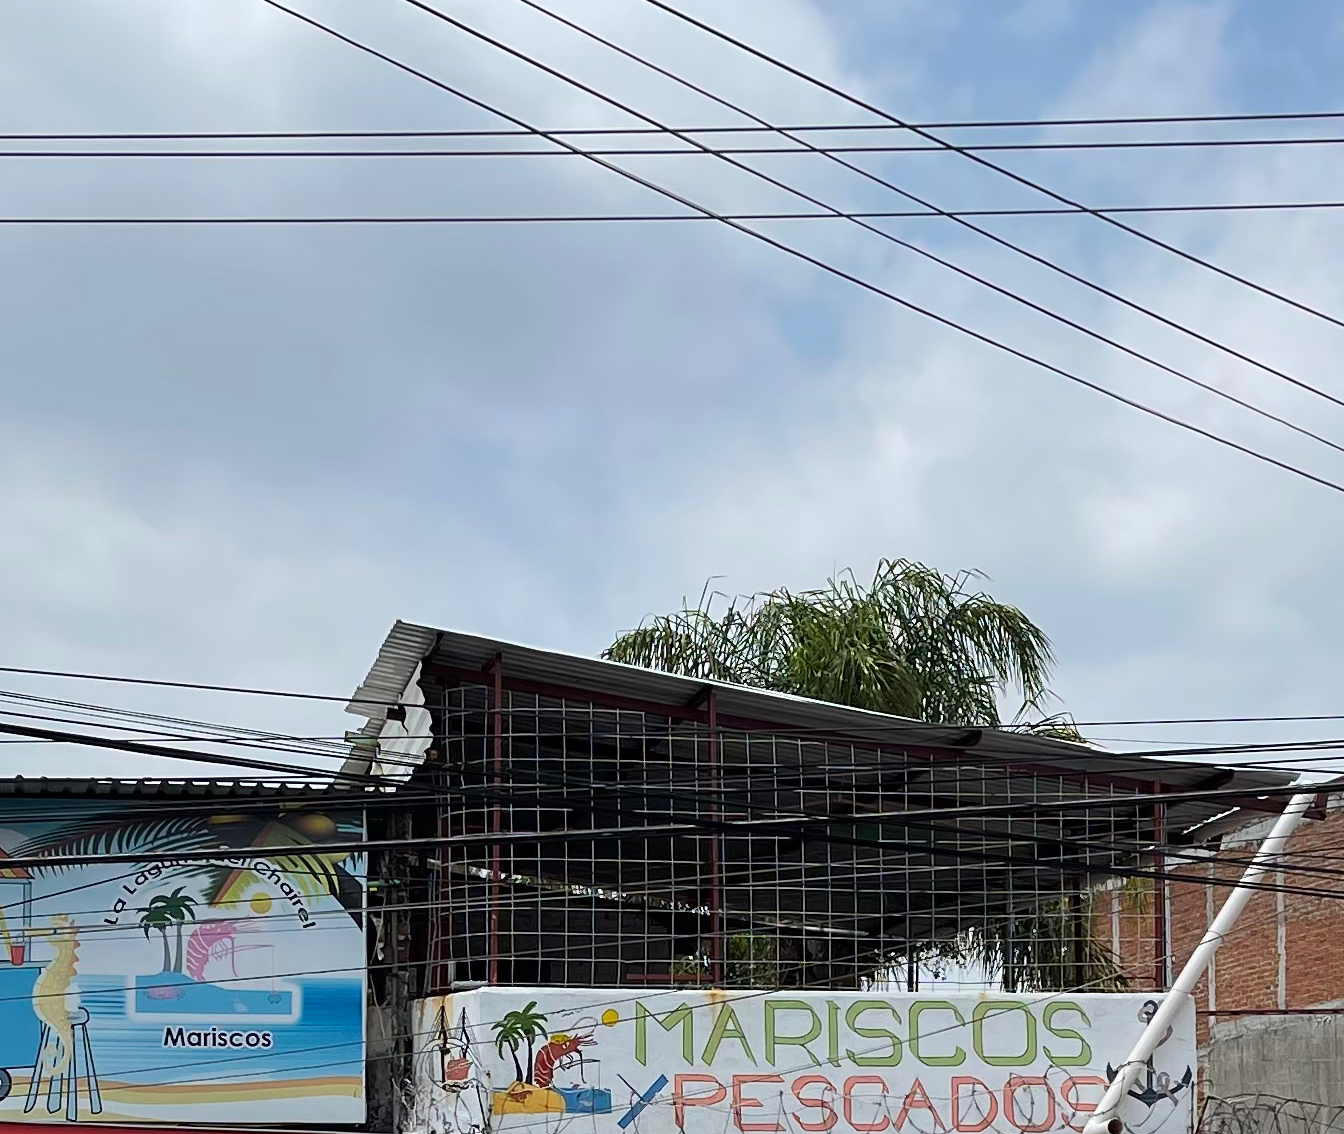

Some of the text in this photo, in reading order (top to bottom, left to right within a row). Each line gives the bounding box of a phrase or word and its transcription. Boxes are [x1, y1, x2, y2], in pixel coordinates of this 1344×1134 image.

[103, 897, 128, 925] La
[253, 860, 316, 929] Chairel
[163, 1026, 273, 1050] Mariscos
[634, 999, 1093, 1068] MARISCOS
[673, 1073, 1110, 1134] PESCADOS
